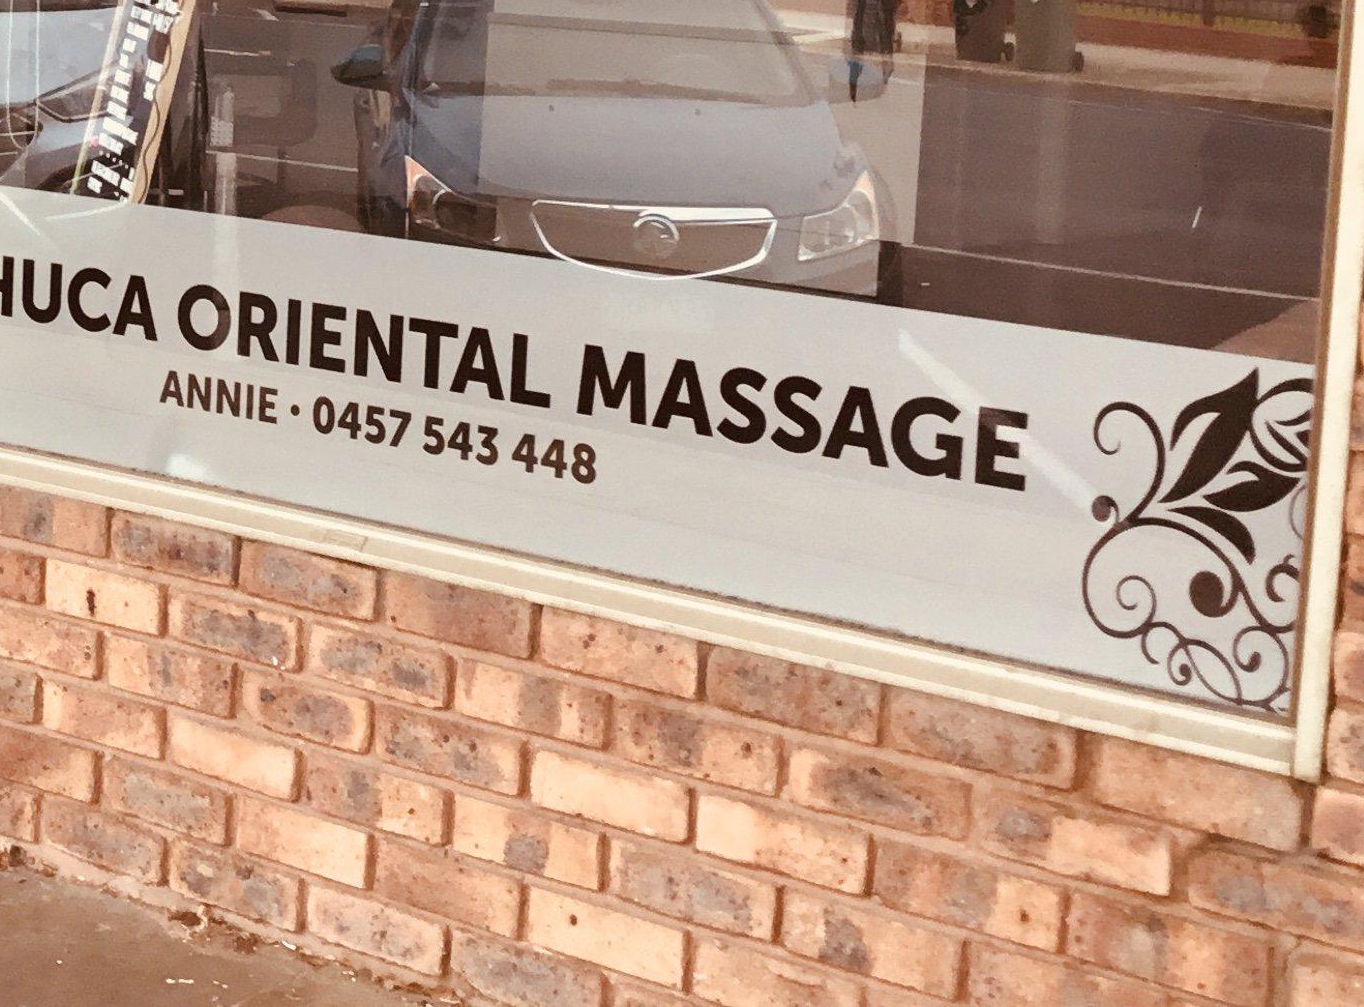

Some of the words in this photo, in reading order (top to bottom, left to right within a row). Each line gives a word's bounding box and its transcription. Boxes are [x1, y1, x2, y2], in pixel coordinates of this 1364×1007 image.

[160, 370, 278, 424] ANNIE
[312, 395, 412, 448] 0457
[422, 415, 500, 466] 543
[511, 432, 597, 485] 448
[177, 284, 552, 407] ORIENTAL
[576, 344, 1029, 492] MASSAGE
